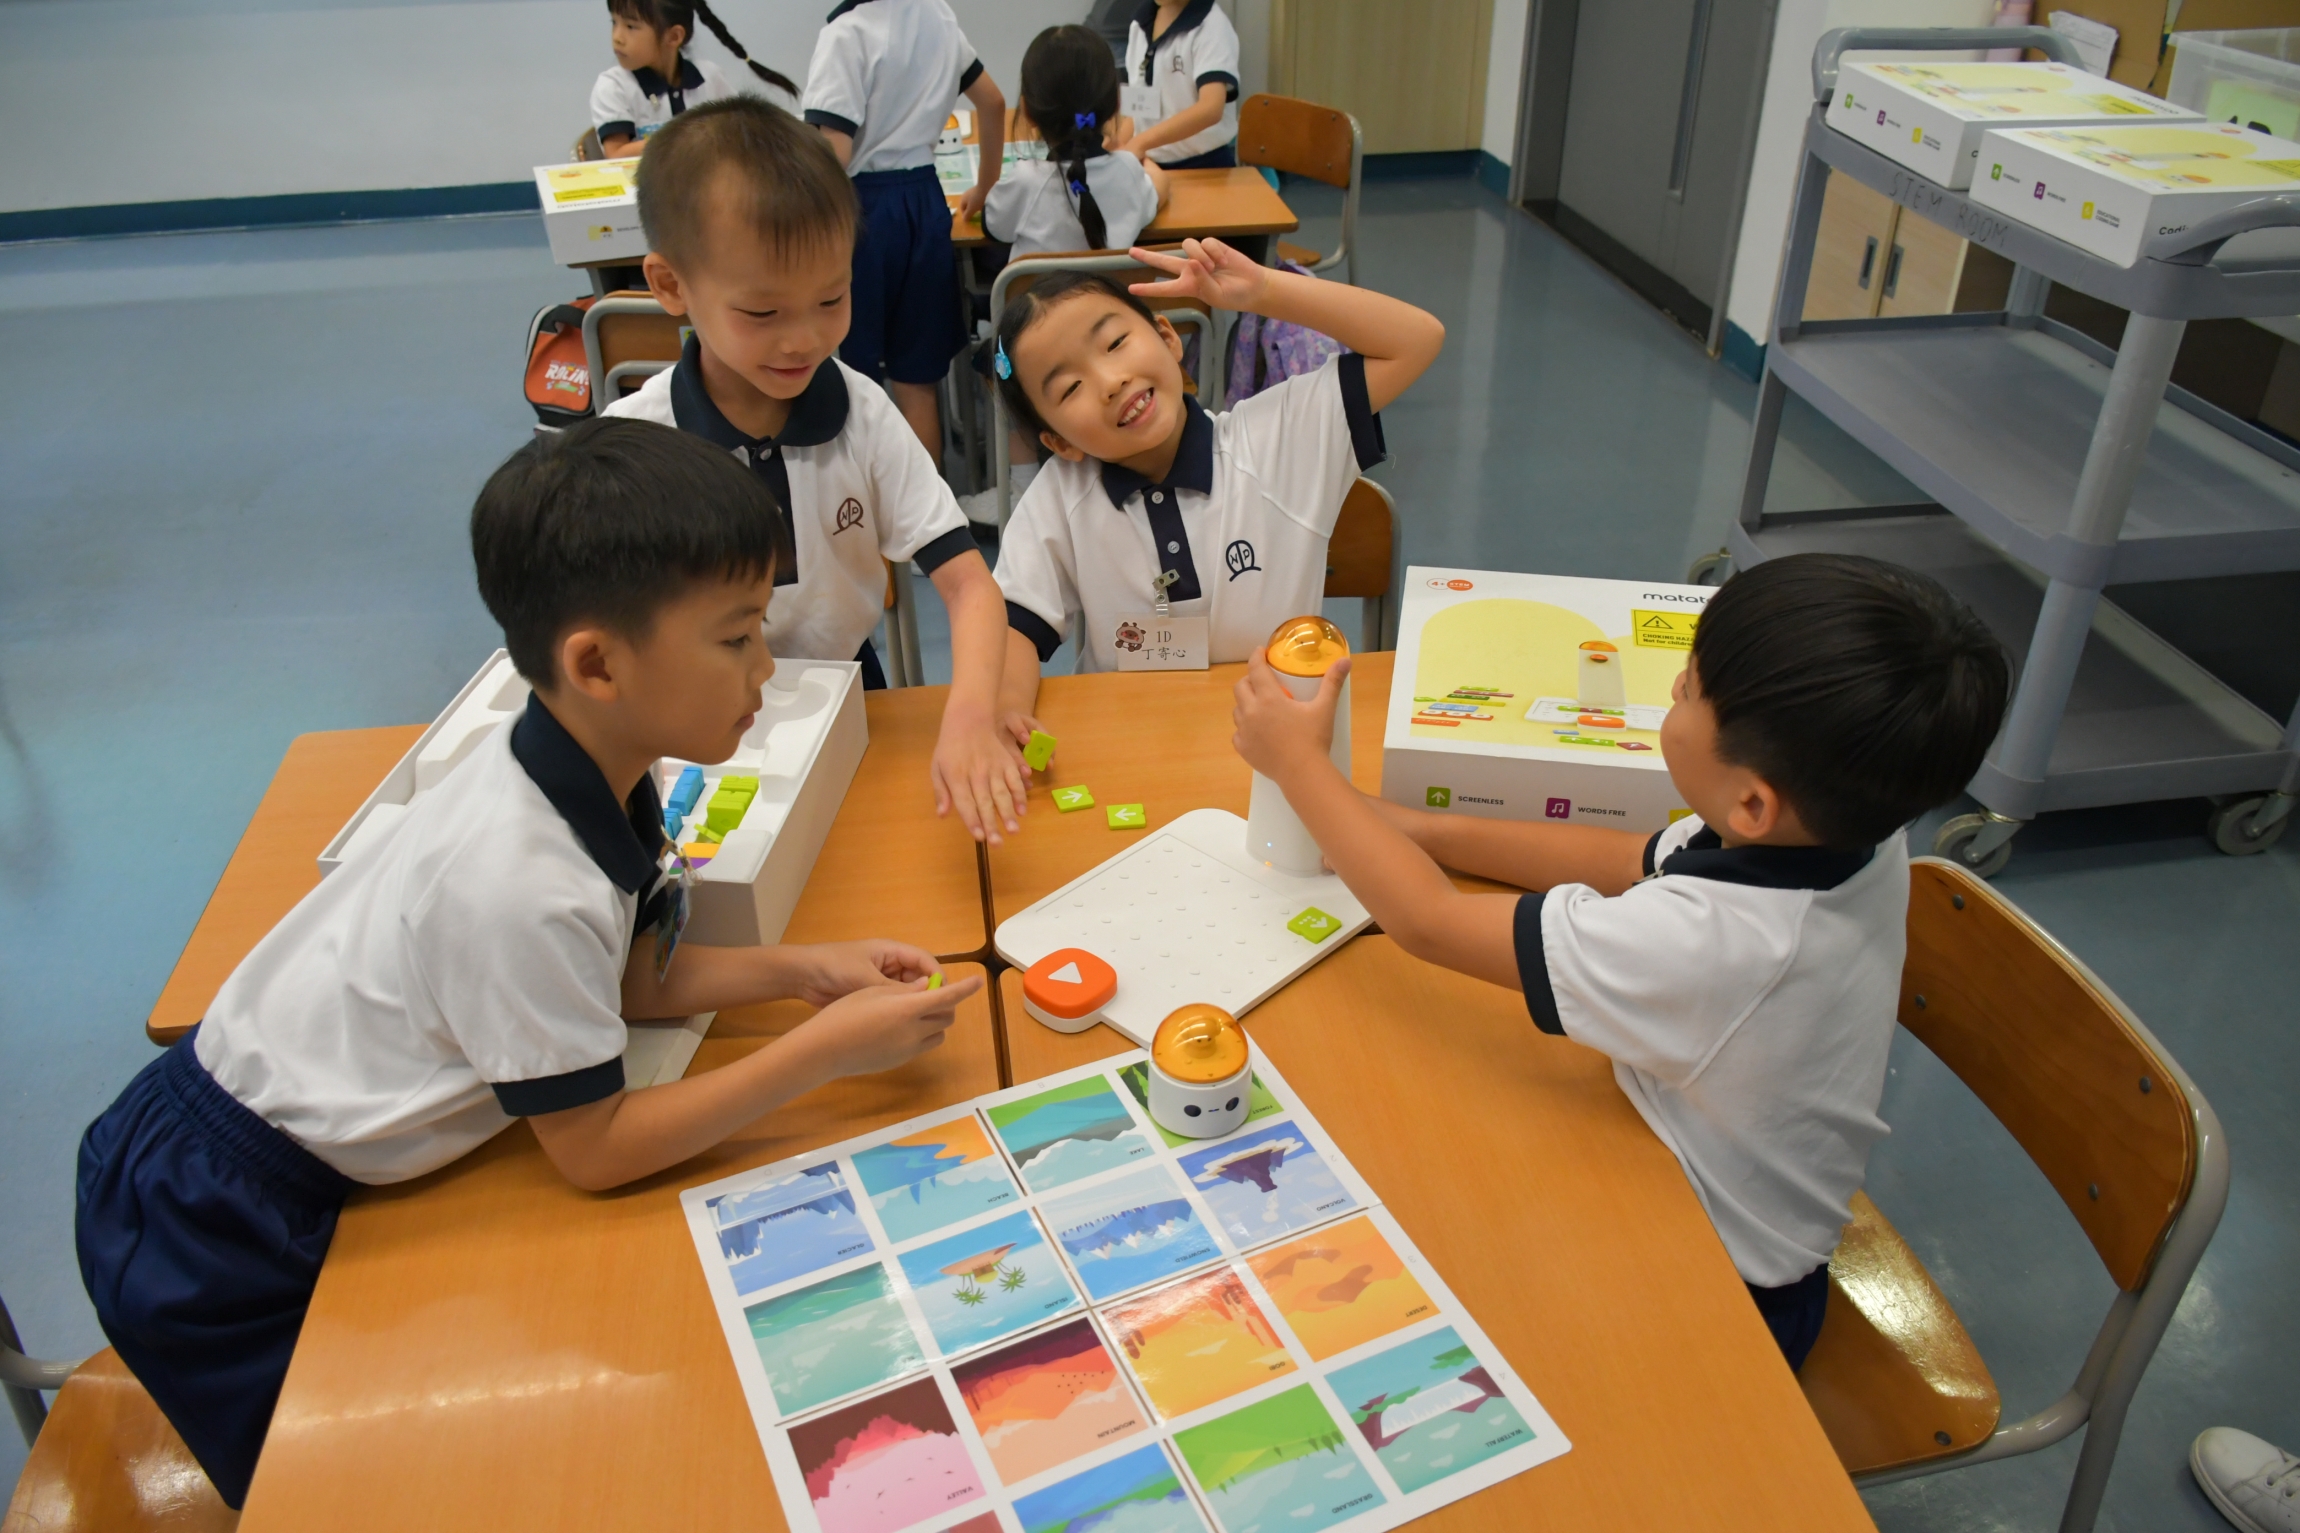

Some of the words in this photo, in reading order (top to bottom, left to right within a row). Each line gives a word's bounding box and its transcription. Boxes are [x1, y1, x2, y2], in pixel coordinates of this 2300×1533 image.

[1889, 171, 1943, 218] STEM
[1956, 202, 2008, 248] ROOM
[1156, 631, 1172, 643] 1D
[1643, 633, 1675, 641] CHOKING
[1458, 796, 1504, 806] SCREENLESS
[1577, 806, 1607, 815] WORDS
[1608, 809, 1627, 817] FREE
[1252, 1104, 1274, 1115] FOREST
[1129, 1147, 1145, 1156] LAKE
[987, 1192, 1009, 1203] BEACH
[1316, 1198, 1347, 1212] VOLCANO
[837, 1243, 865, 1255] GLACIER
[1174, 1247, 1211, 1263] SNOWFIELD
[1044, 1296, 1068, 1309] ISLAND
[1405, 1304, 1428, 1318] DESERT
[1268, 1360, 1286, 1371] GOBI
[1097, 1419, 1136, 1439] MOUNTAIN
[1484, 1427, 1523, 1447] WATERFALL
[946, 1485, 974, 1501] VALLEY
[1331, 1492, 1374, 1514] GRASSLAND
